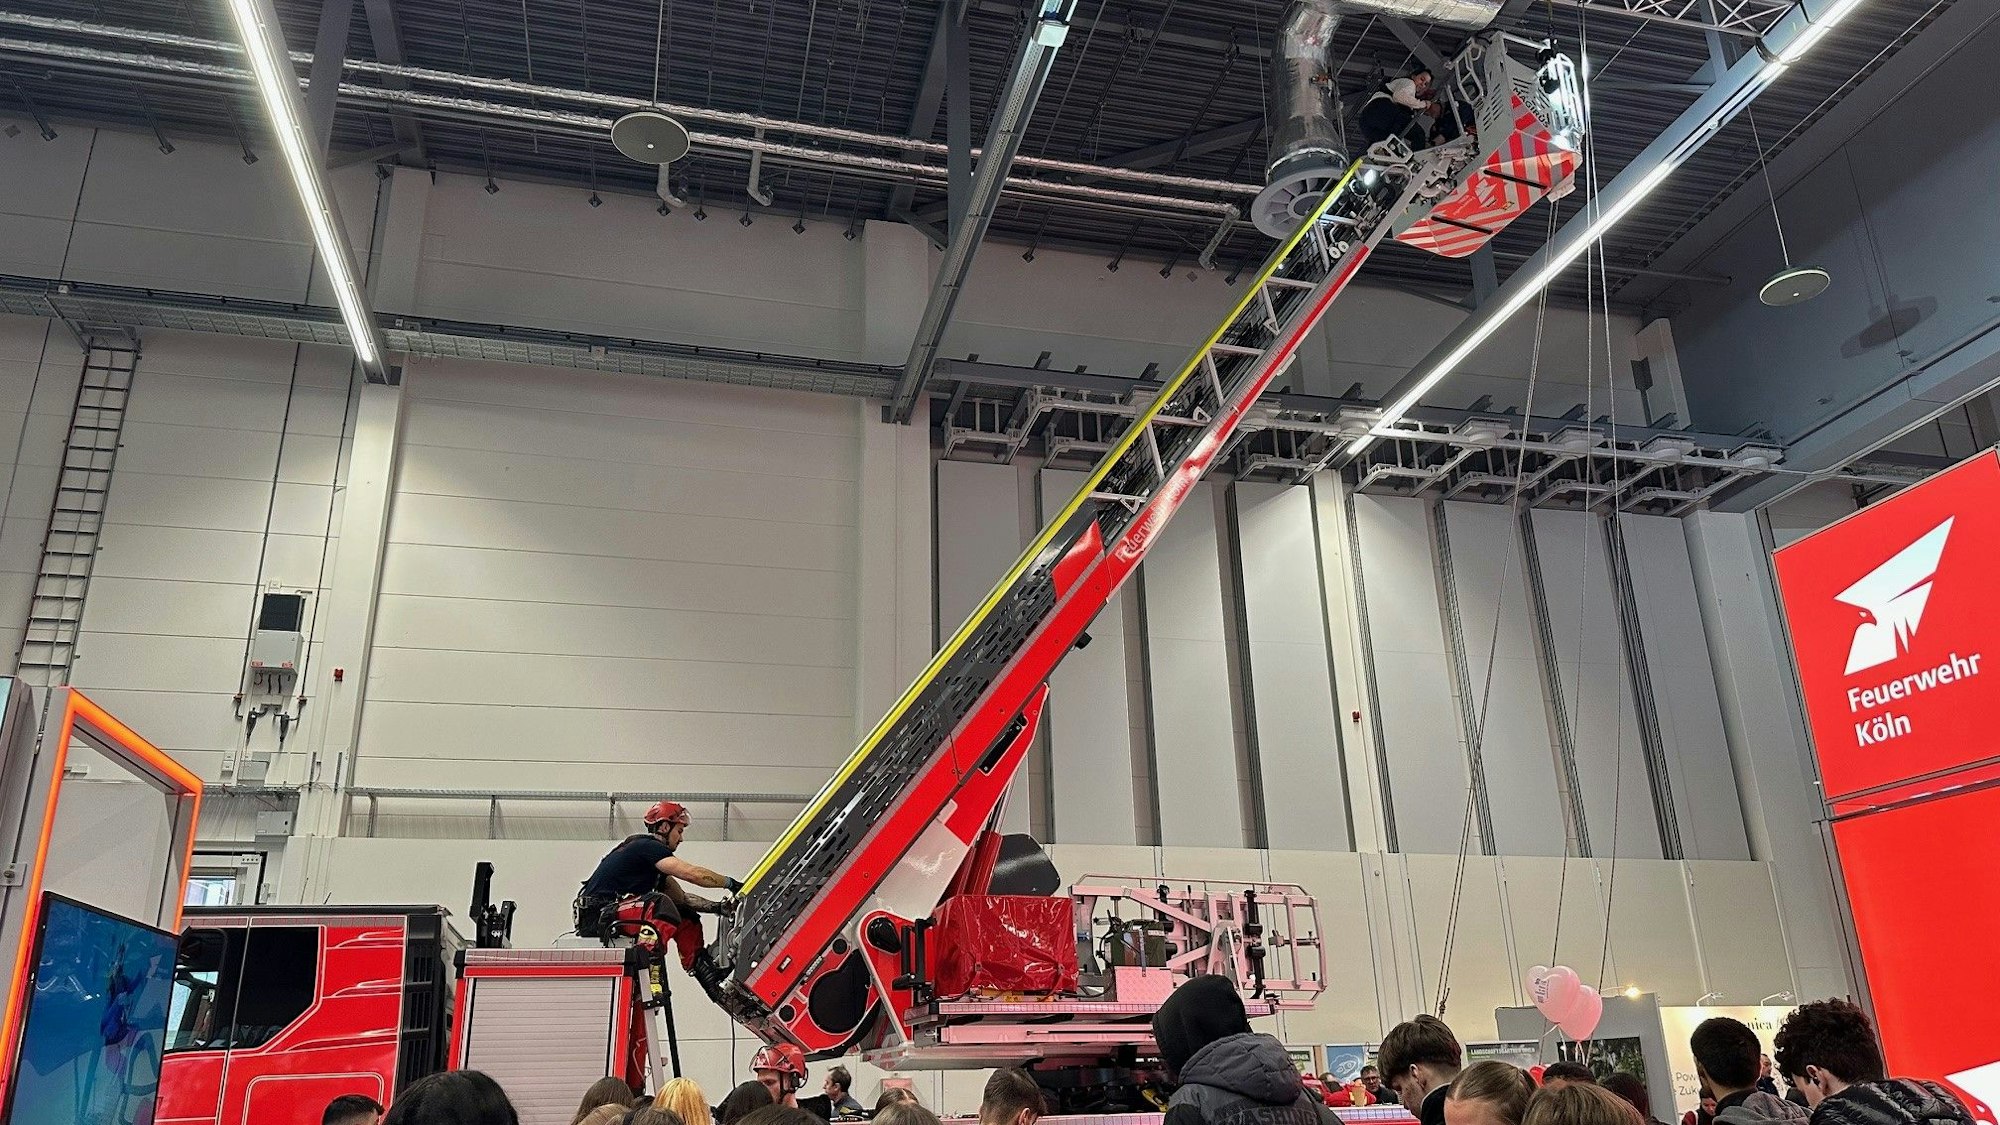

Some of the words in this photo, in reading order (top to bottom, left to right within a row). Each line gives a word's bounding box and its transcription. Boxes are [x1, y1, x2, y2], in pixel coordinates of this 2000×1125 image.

[1512, 87, 1550, 128] MAGIRUS
[1846, 652, 1981, 714] Feuerwehr
[1854, 711, 1912, 748] Köln
